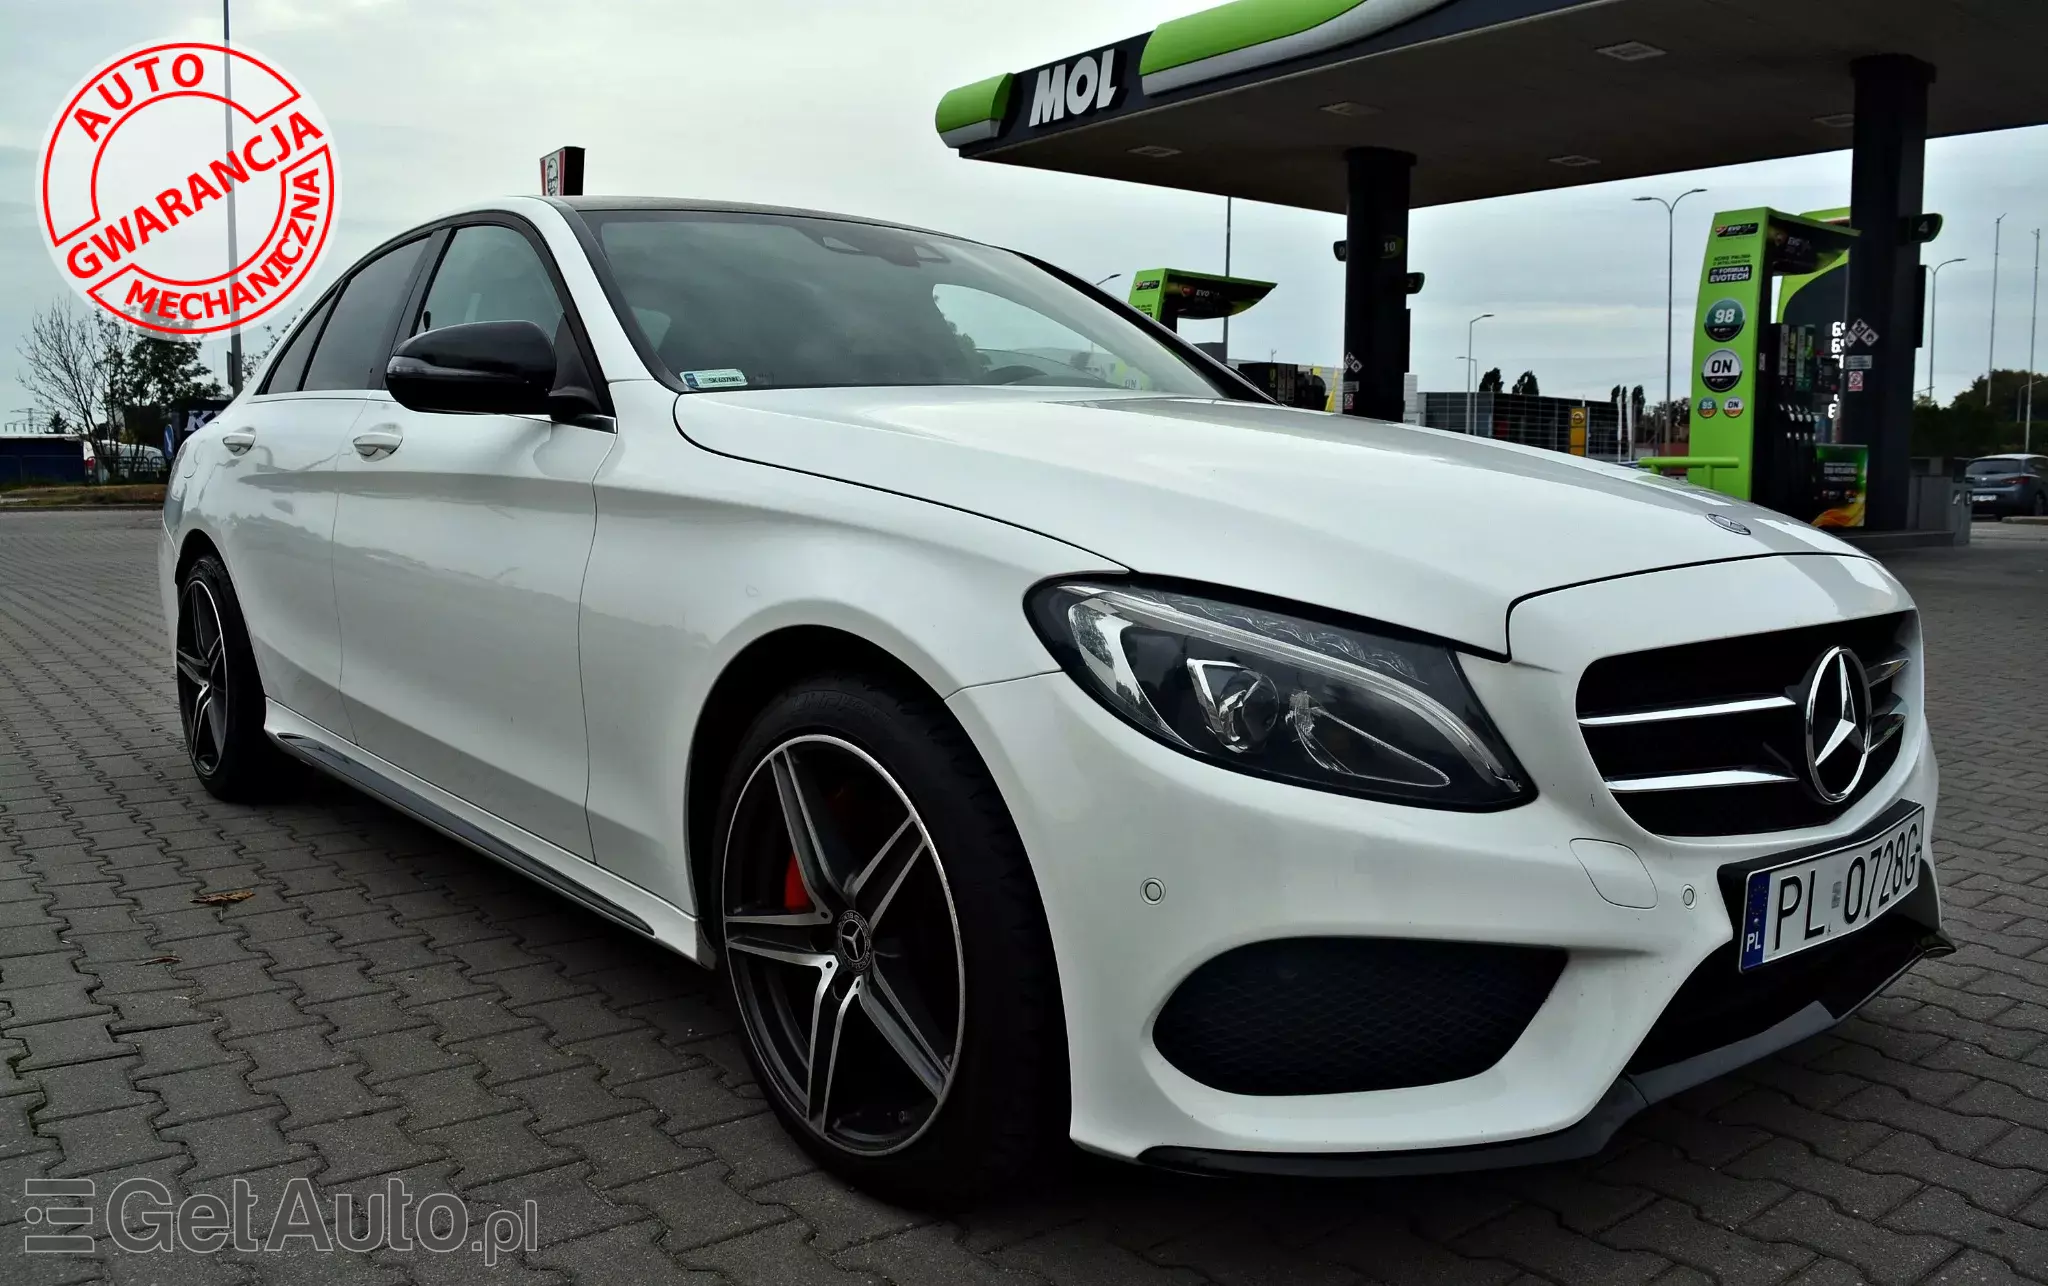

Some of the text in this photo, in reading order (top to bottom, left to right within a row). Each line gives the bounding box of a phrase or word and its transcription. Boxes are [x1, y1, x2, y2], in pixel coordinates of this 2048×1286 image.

[1028, 48, 1117, 127] MOL
[1710, 273, 1749, 282] EVOTECH
[1714, 308, 1735, 324] 98
[1711, 359, 1732, 374] ON
[1701, 401, 1713, 409] 95
[184, 410, 223, 431] K
[1774, 870, 1824, 951] PL
[1746, 931, 1761, 952] PL
